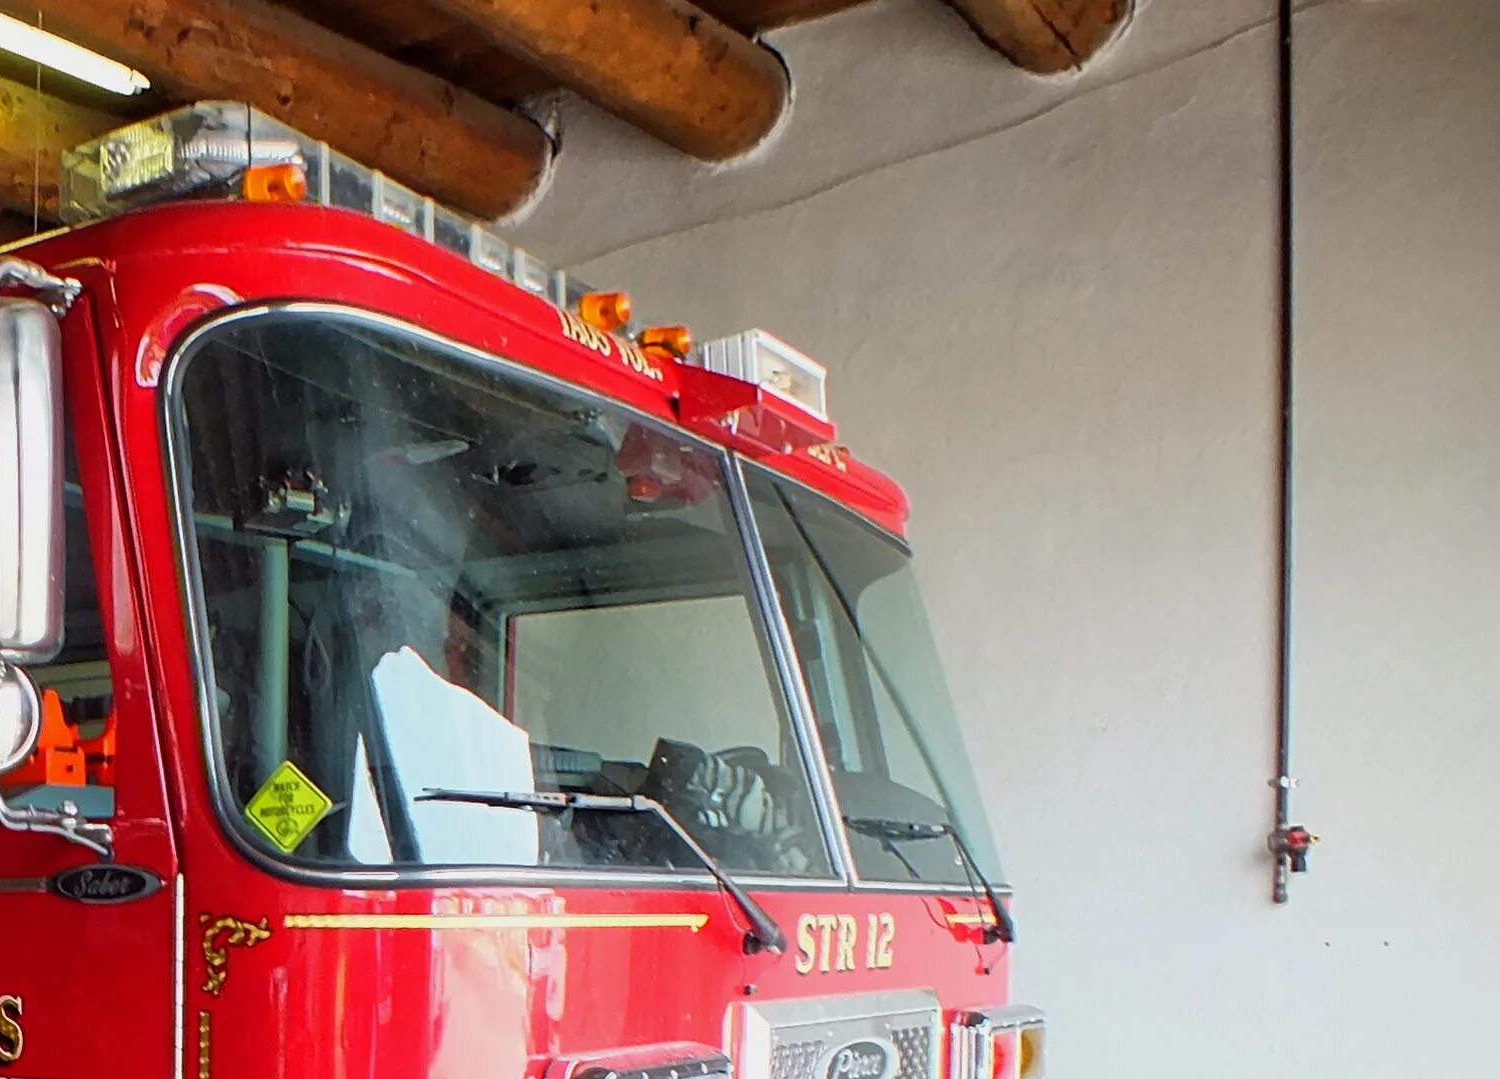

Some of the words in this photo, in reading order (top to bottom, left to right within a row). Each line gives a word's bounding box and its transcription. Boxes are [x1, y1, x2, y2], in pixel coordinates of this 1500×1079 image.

[273, 782, 300, 792] WATCH
[278, 793, 295, 803] FOR
[260, 804, 315, 817] MOTORCYCLES
[794, 913, 858, 976] STR
[866, 912, 896, 969] 12
